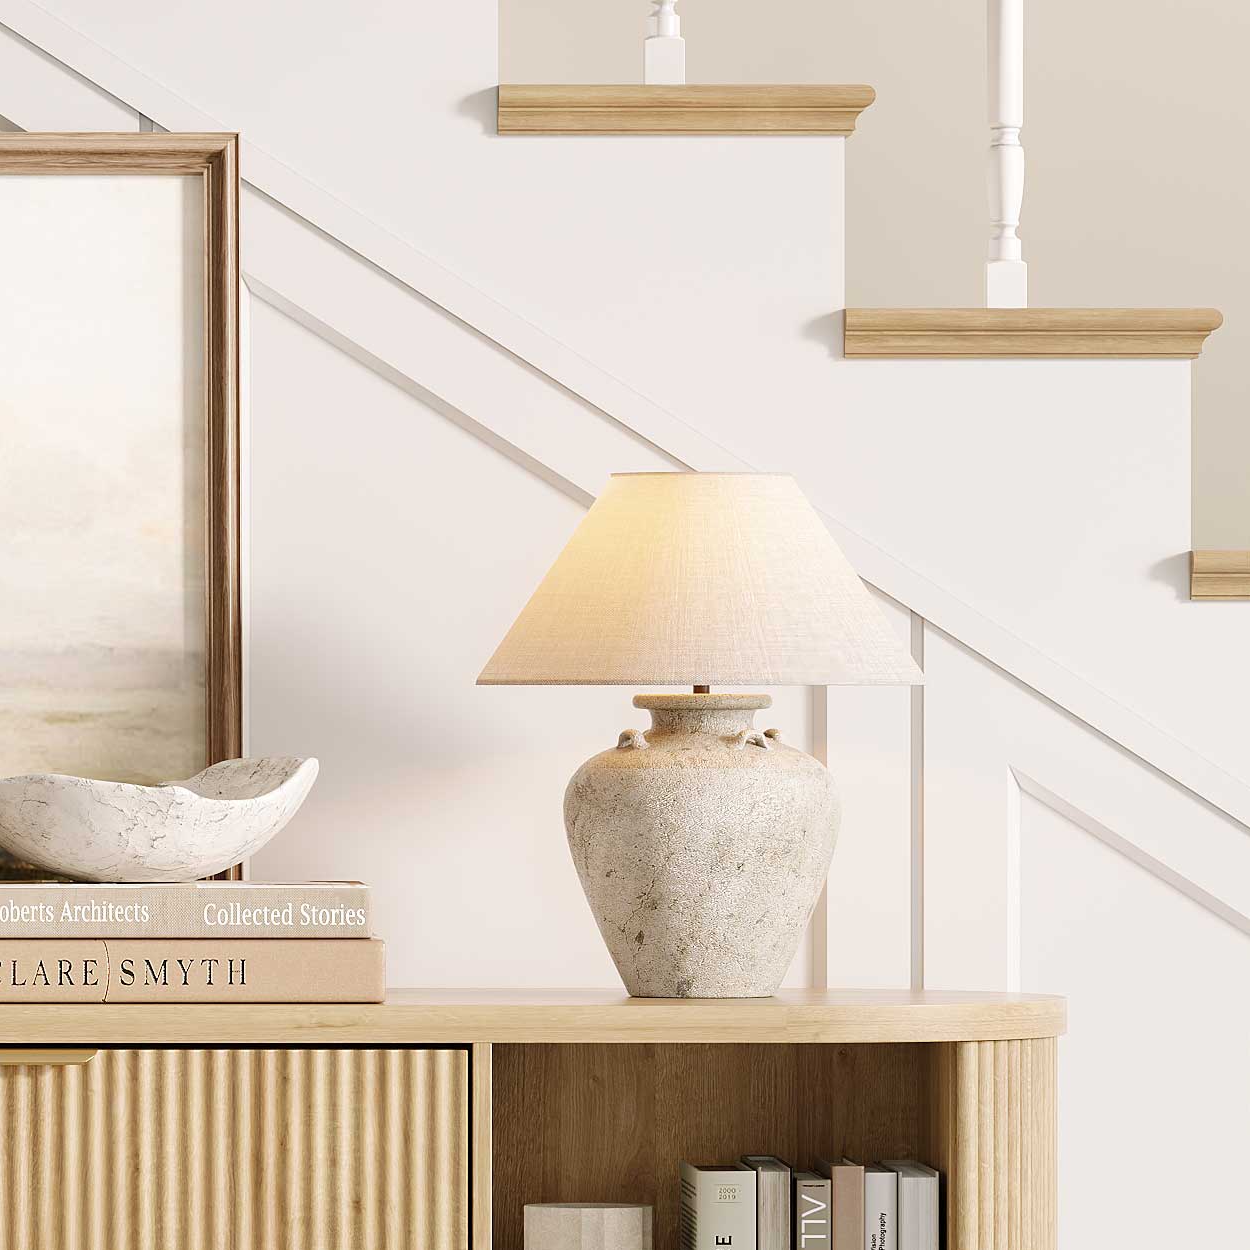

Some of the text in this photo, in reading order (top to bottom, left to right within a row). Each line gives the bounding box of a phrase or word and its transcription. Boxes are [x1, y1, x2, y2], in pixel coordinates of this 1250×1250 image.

[60, 899, 150, 923] Architects
[203, 902, 366, 928] Collected Stories
[119, 958, 248, 987] SMYTH
[801, 1194, 827, 1249] ALL
